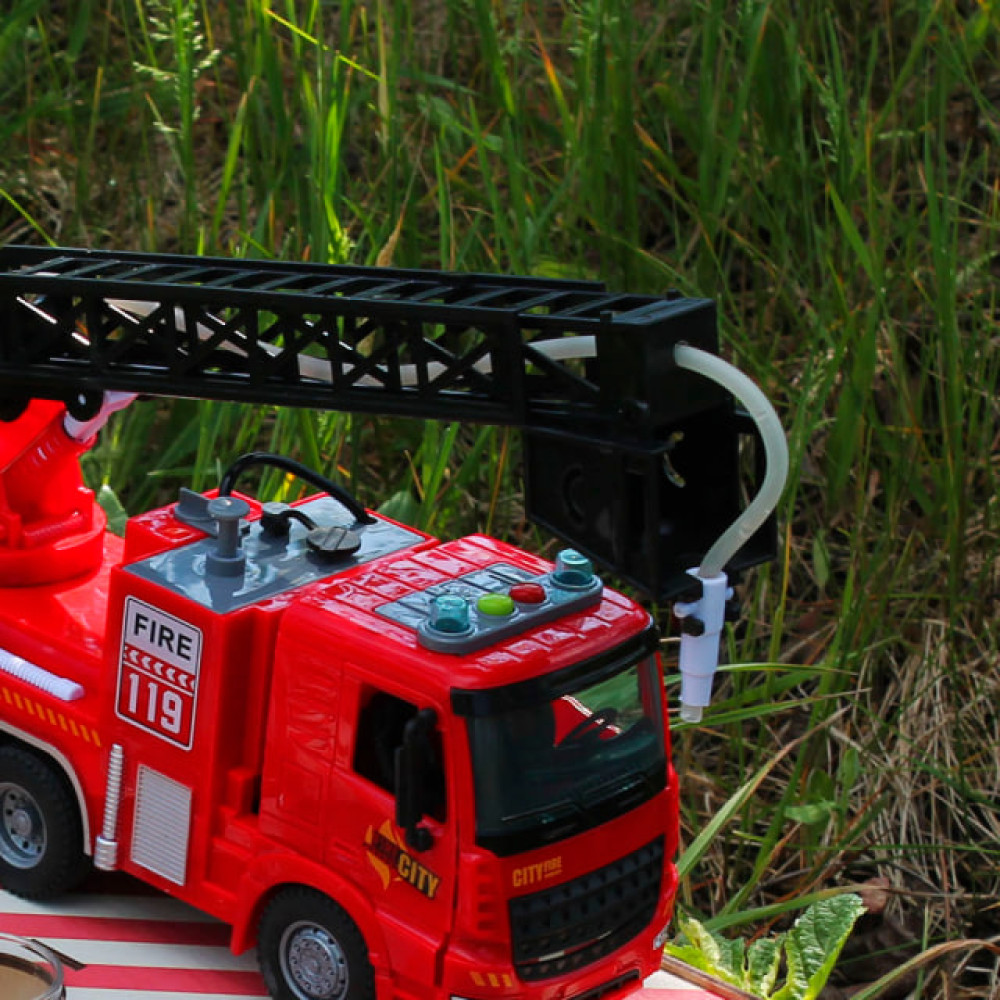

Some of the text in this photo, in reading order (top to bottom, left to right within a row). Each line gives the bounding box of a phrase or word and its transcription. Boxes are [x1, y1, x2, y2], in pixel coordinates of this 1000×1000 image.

[133, 612, 193, 661] FIRE
[128, 673, 182, 734] 119
[398, 852, 440, 898] CITY
